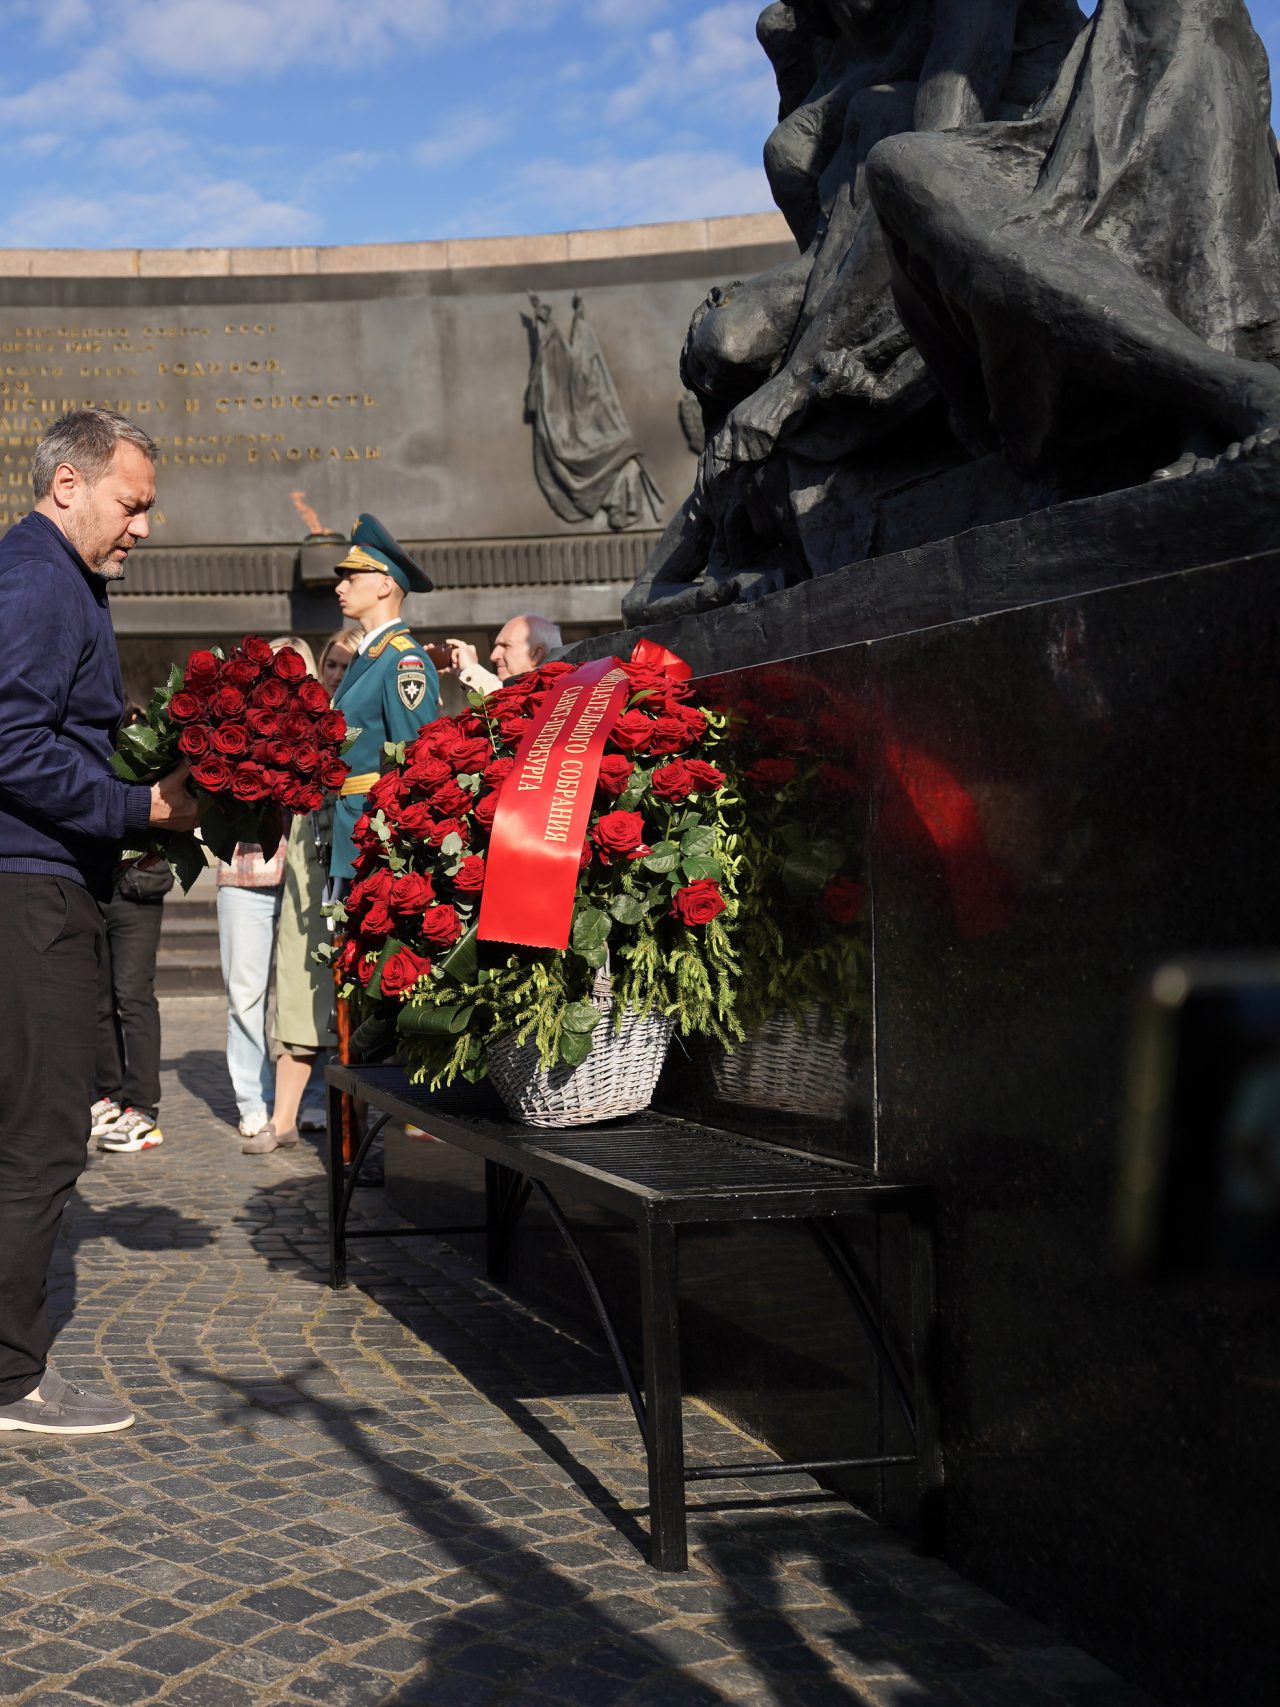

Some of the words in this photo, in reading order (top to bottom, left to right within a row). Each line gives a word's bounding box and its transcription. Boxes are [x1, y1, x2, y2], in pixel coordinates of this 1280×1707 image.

[185, 399, 200, 413] И
[247, 447, 382, 465] БЛОКАДЫ
[518, 685, 584, 792] САНКТ-ПЕТЕРБУРГА
[544, 760, 584, 844] СОБРАНИЯ
